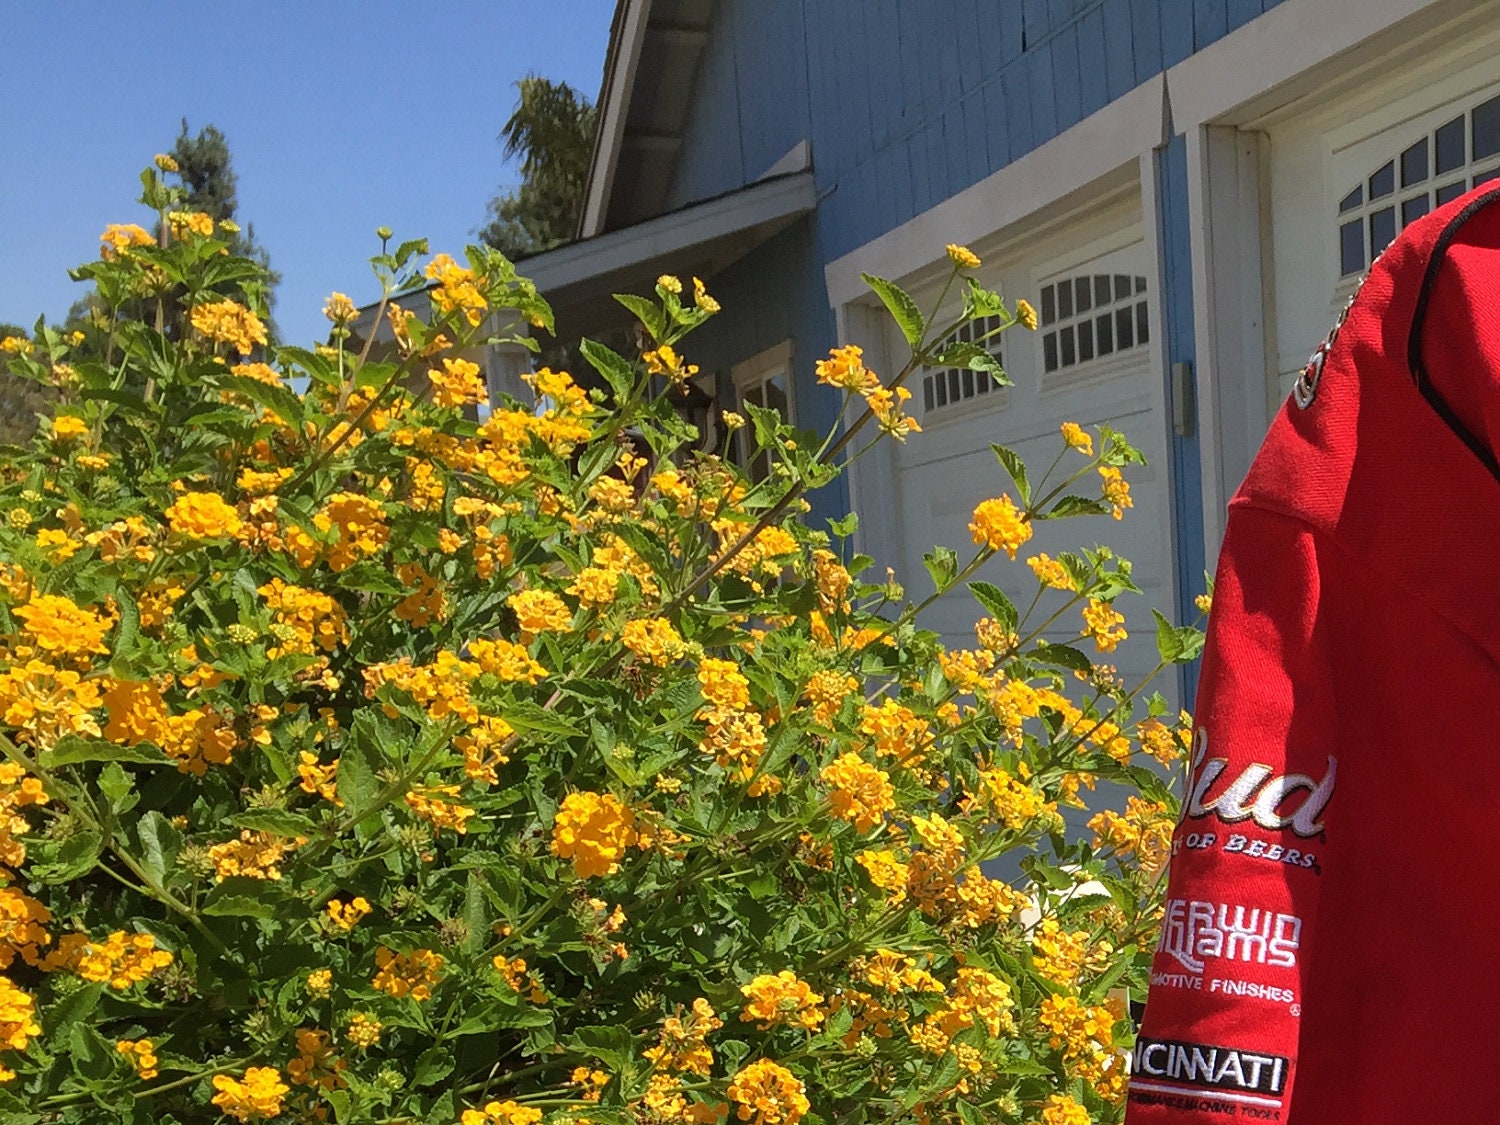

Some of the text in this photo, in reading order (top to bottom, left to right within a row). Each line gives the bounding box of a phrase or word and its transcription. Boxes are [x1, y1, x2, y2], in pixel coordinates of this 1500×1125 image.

[1222, 833, 1317, 869] BEERS
[1210, 979, 1294, 1003] FINISHES
[1131, 1040, 1283, 1093] NCINNATI
